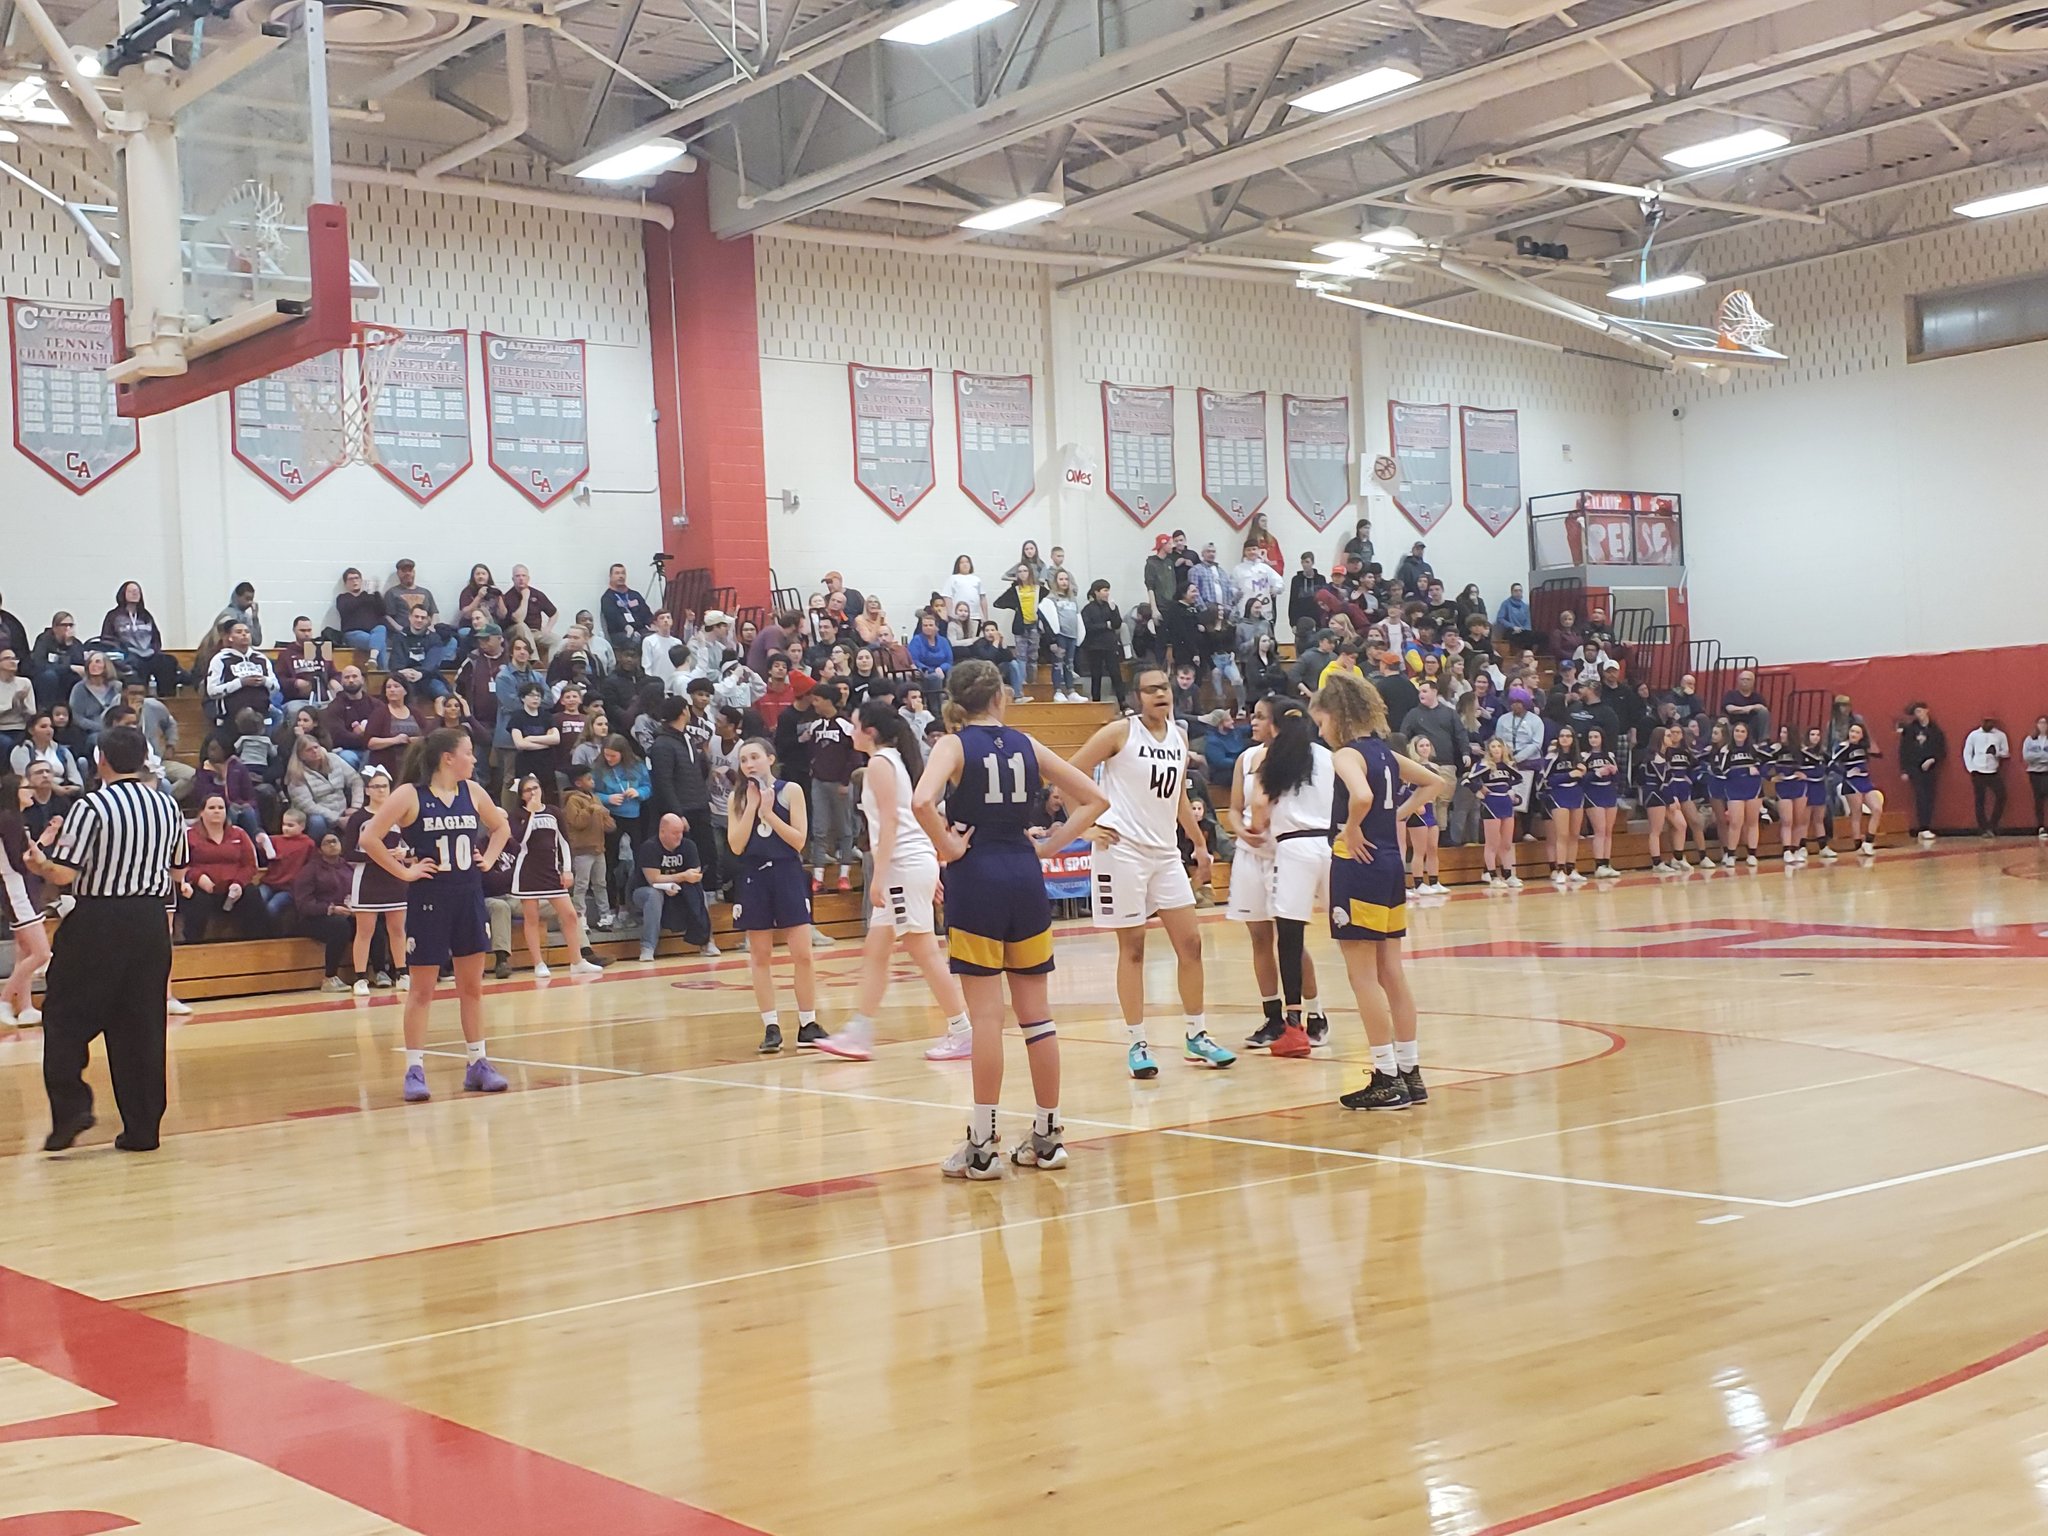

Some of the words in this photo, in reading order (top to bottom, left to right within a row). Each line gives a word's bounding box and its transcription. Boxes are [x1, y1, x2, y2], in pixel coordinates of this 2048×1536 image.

[20, 348, 113, 364] CHAMPIONSHI
[44, 337, 104, 351] TENNIS
[492, 365, 580, 380] CHEERLEADING
[494, 378, 583, 392] CHAMPIONSHIPS
[412, 464, 433, 488] CA
[531, 469, 553, 493] CA
[982, 752, 1028, 804] 11
[1150, 764, 1177, 798] 40
[1383, 765, 1394, 809] 1
[435, 833, 472, 872] 10
